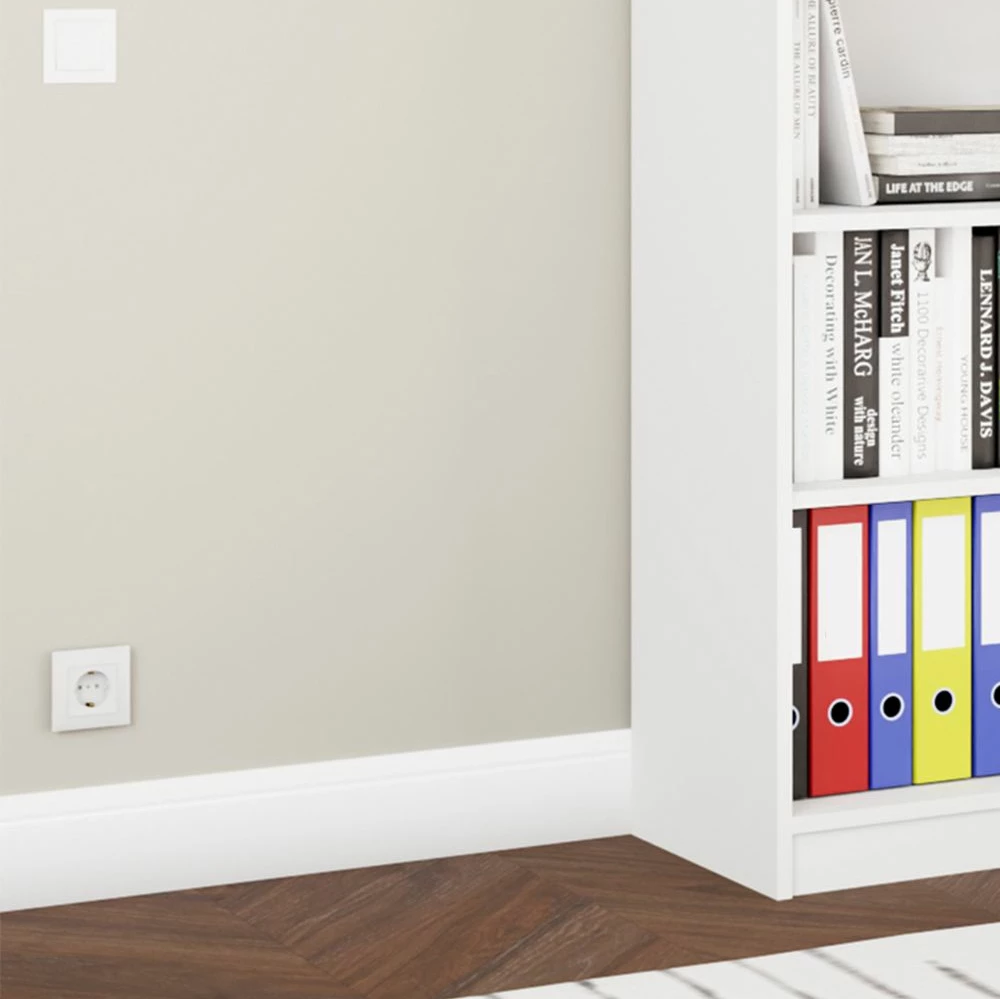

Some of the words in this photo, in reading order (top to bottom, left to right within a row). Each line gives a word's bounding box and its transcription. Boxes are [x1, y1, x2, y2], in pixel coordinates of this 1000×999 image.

[807, 57, 817, 70] OF
[835, 36, 852, 80] cardin
[807, 73, 817, 118] BEAUTY
[885, 181, 908, 194] LIFE
[909, 181, 923, 193] AT
[924, 181, 945, 193] THE
[946, 180, 974, 192] EDGE
[853, 237, 873, 266] JAN
[890, 243, 906, 287] Janet
[822, 254, 838, 343] Decorating
[854, 270, 873, 287] L.
[890, 289, 906, 334] Fitch
[917, 291, 930, 325] 1100
[979, 269, 993, 366] LENNARD
[853, 291, 873, 378] McHARG
[825, 347, 838, 382] with
[891, 342, 905, 386] white
[917, 329, 930, 404] Decorative
[960, 354, 969, 404] YOUNG
[979, 366, 993, 378] J.
[825, 386, 838, 436] White
[853, 396, 865, 424] with
[862, 408, 878, 447] design
[891, 389, 905, 460] oleander
[979, 380, 993, 439] DAVIS
[853, 425, 865, 466] nature
[913, 406, 930, 460] Designs
